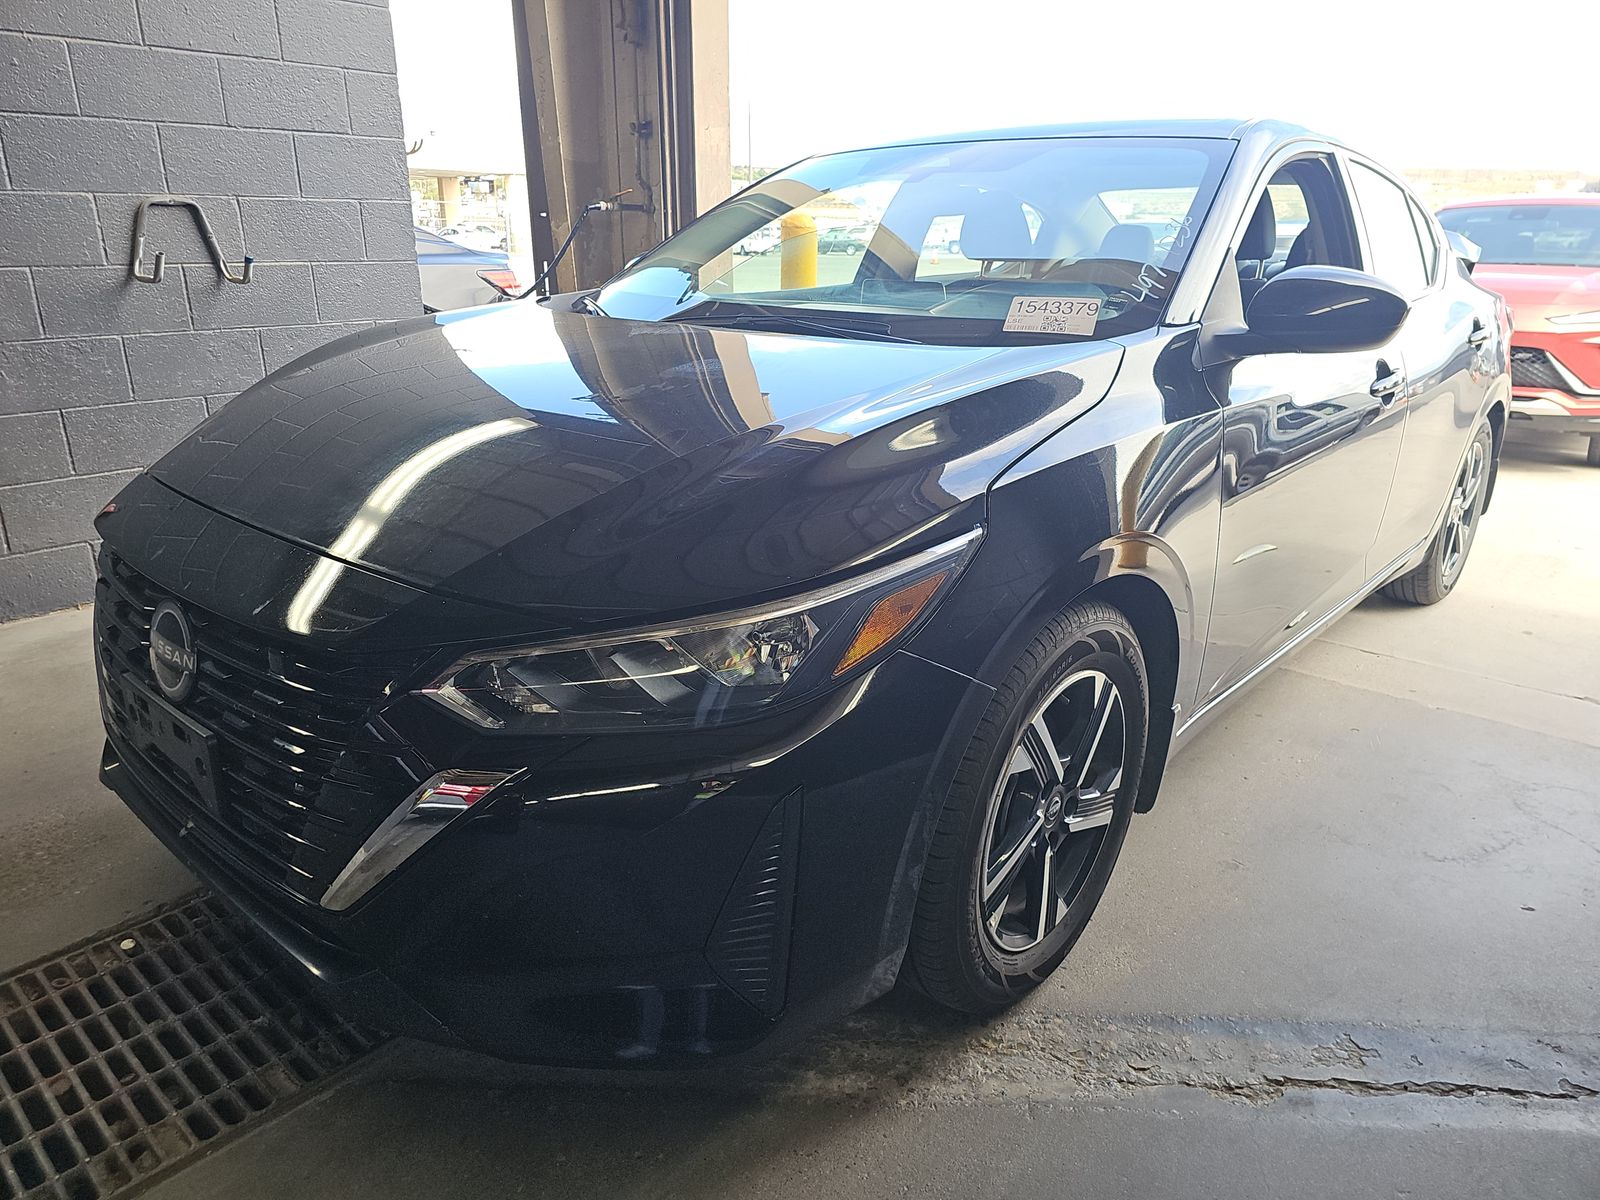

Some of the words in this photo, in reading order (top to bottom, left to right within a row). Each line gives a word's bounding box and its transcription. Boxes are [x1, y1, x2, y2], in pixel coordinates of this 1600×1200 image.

[1120, 262, 1167, 302] 497
[1016, 300, 1099, 316] 1543379
[156, 639, 194, 671] SSAN
